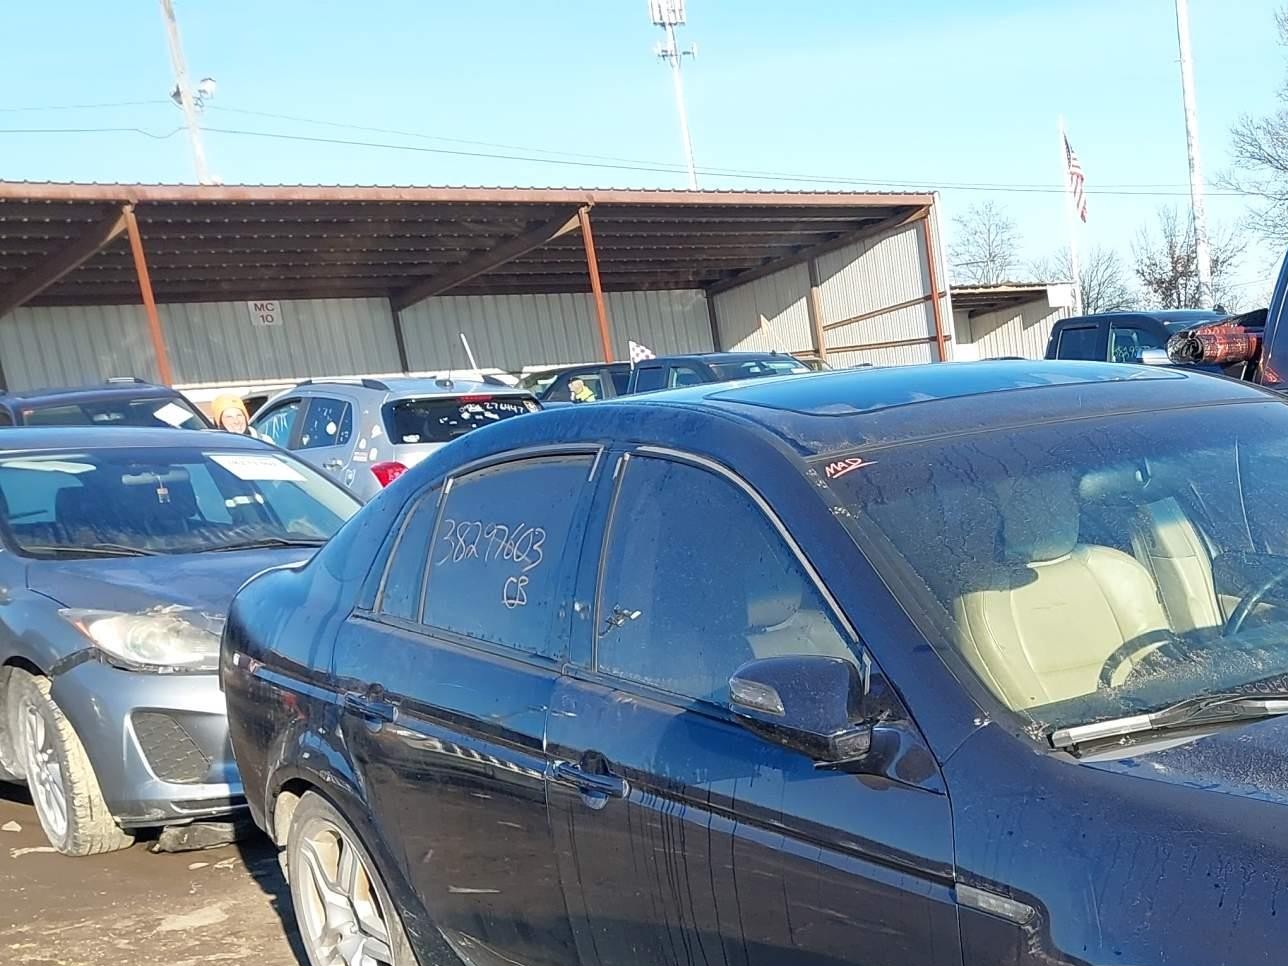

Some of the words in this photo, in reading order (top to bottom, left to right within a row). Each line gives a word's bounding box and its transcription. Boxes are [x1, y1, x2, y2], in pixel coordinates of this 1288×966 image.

[254, 303, 275, 312] MC
[260, 314, 274, 324] 10
[435, 519, 546, 573] 38297603
